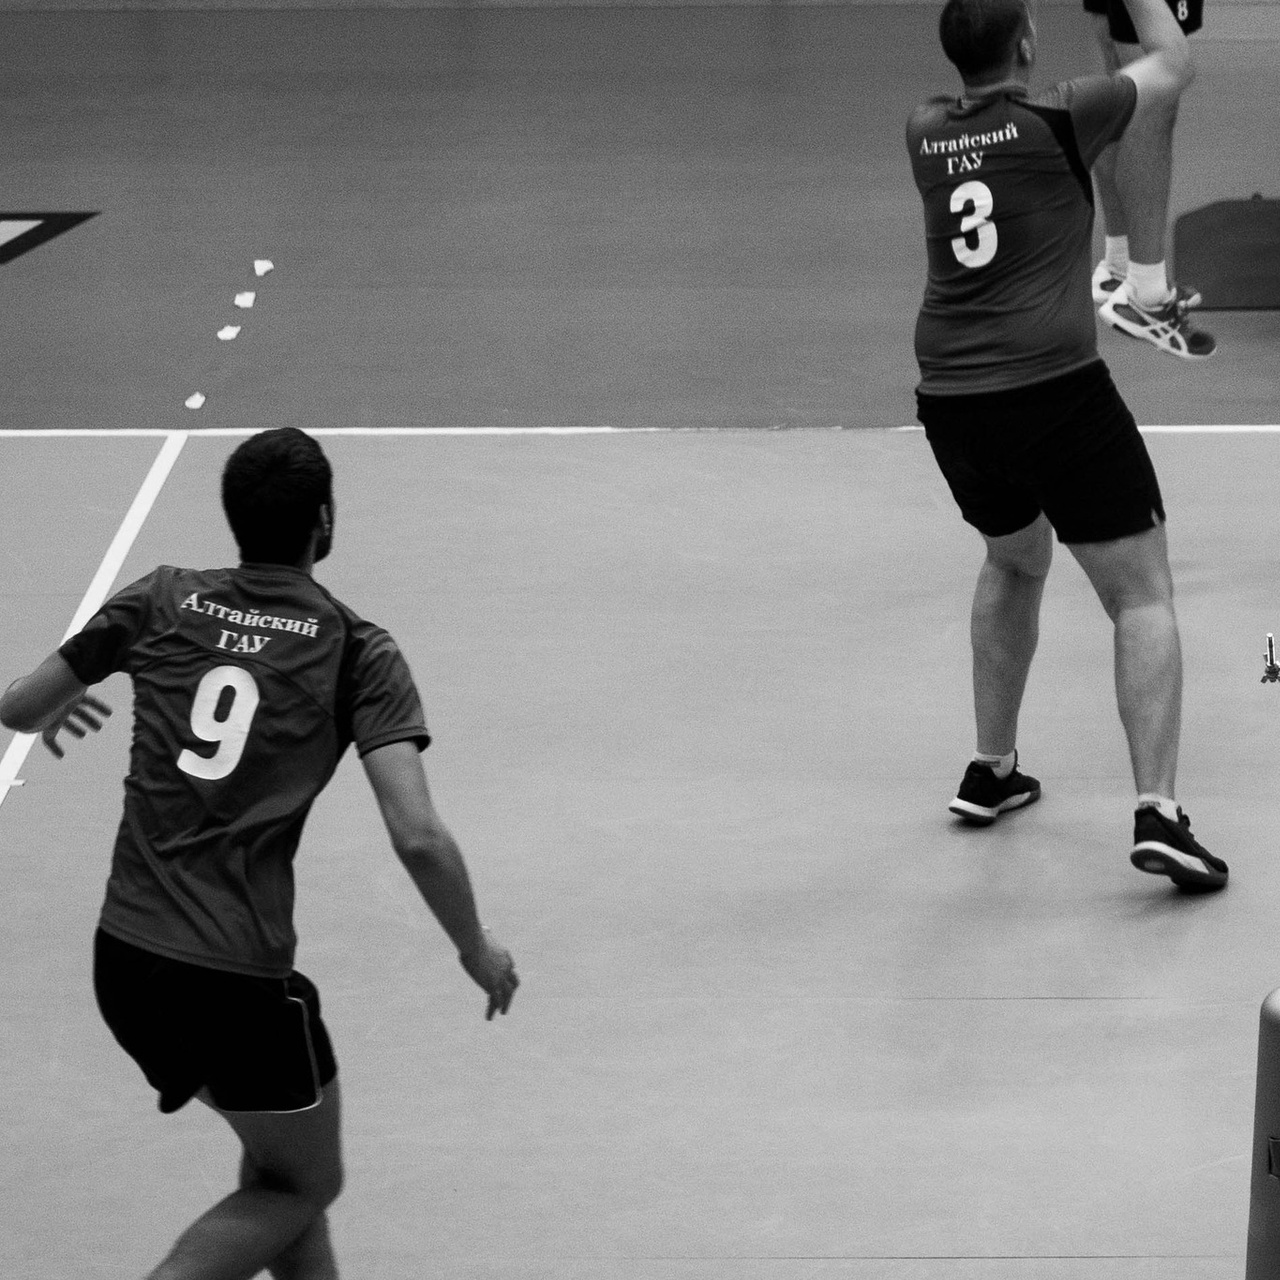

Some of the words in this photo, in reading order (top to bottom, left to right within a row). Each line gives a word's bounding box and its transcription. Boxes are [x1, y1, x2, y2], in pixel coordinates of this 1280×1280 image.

[919, 121, 1019, 155] Алтайский
[946, 151, 984, 175] ГАУ
[950, 180, 998, 269] 3
[180, 592, 320, 638] Алтайский
[215, 629, 272, 653] ГАУ
[176, 665, 260, 781] 9
